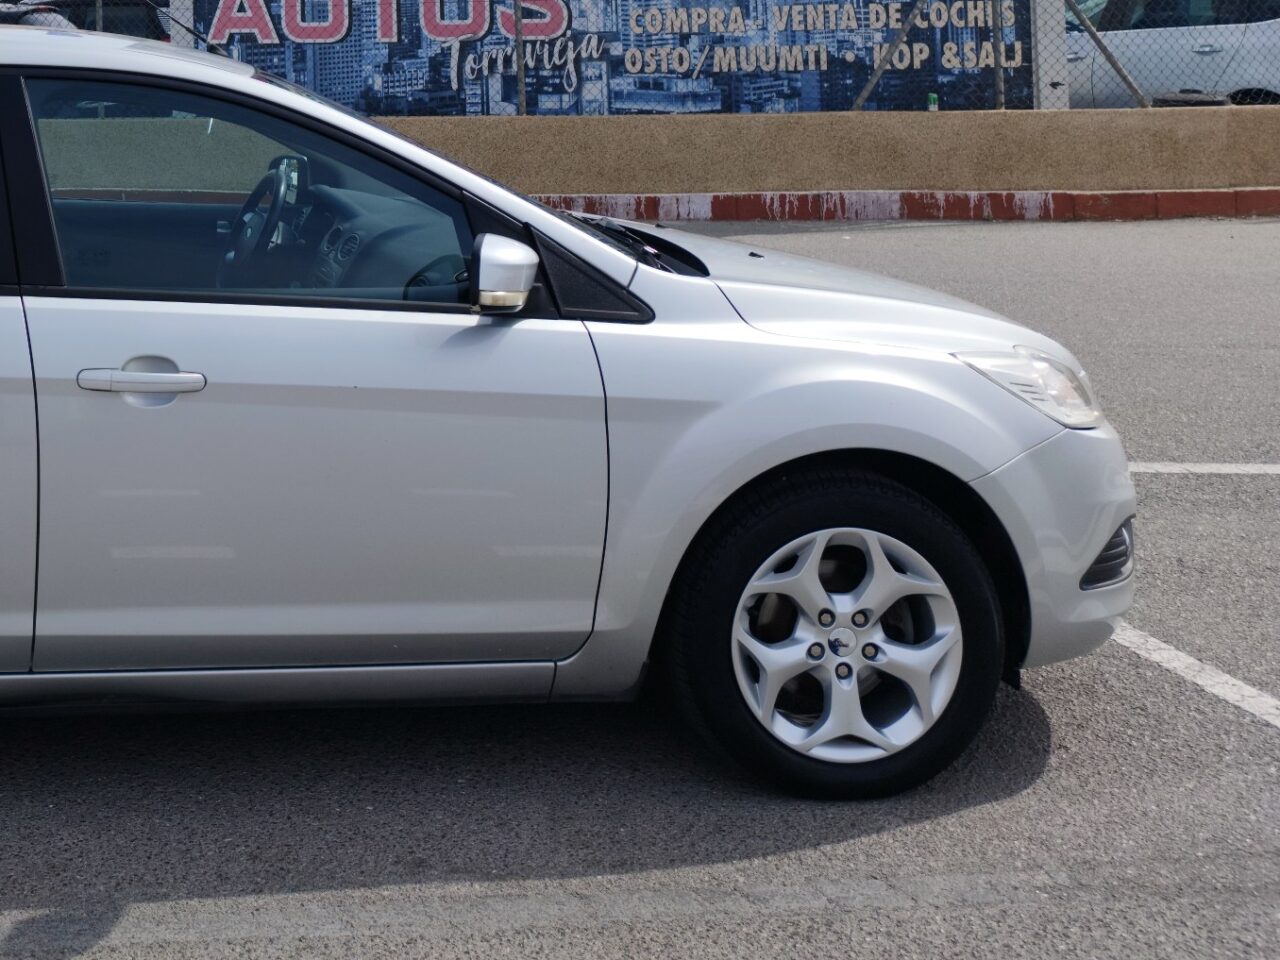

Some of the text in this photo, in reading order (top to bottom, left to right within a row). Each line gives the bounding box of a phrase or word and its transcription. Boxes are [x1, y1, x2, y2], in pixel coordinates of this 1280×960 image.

[629, 6, 745, 35] COMPRA
[773, 2, 860, 32] VENTA
[869, 2, 902, 29] DE
